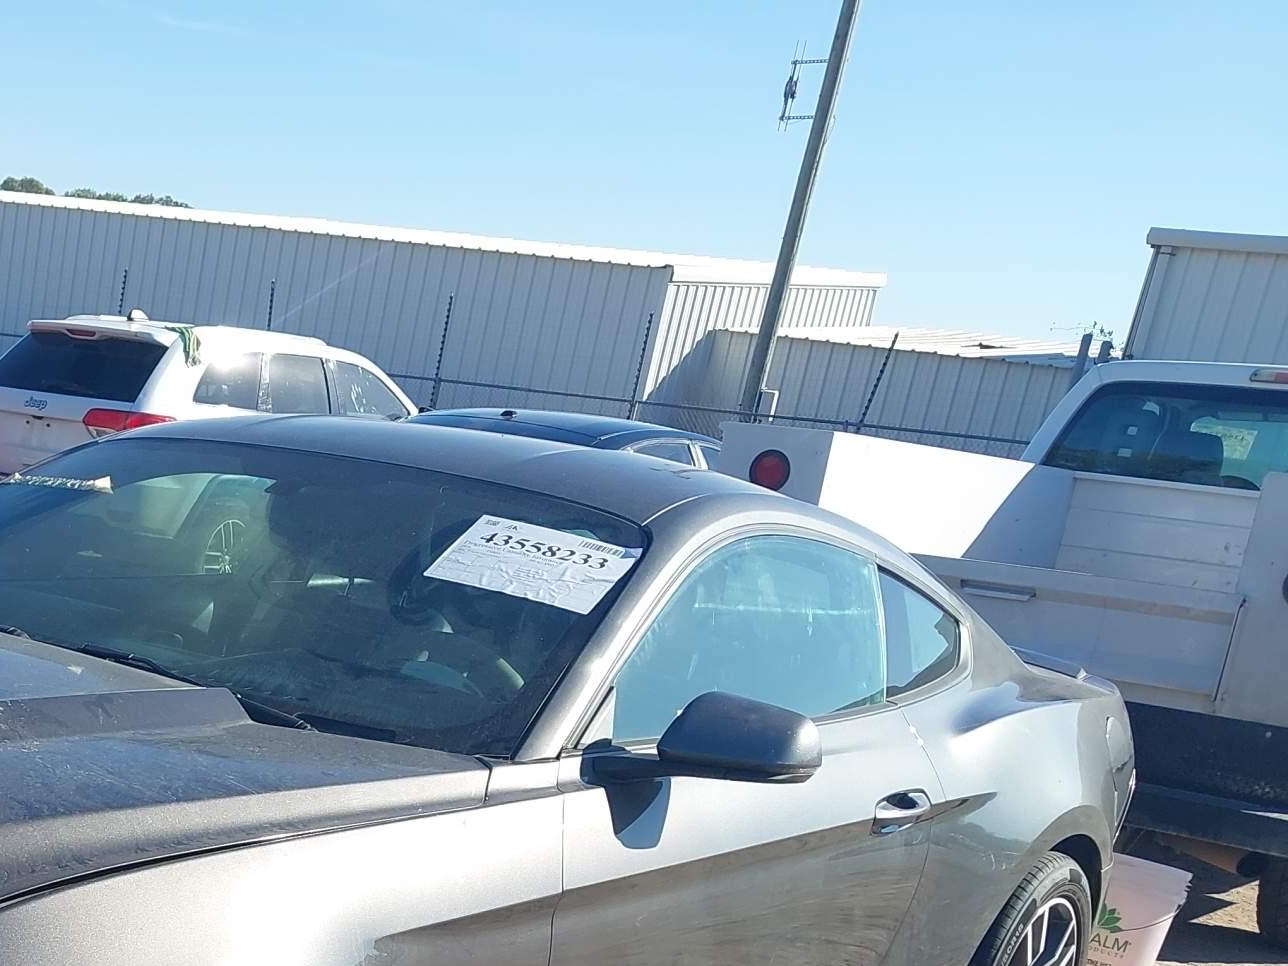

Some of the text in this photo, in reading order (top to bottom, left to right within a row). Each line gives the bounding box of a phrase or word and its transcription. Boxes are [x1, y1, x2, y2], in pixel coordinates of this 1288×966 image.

[24, 396, 48, 411] Jeep
[480, 532, 609, 570] 43558233
[1089, 932, 1129, 953] ALM
